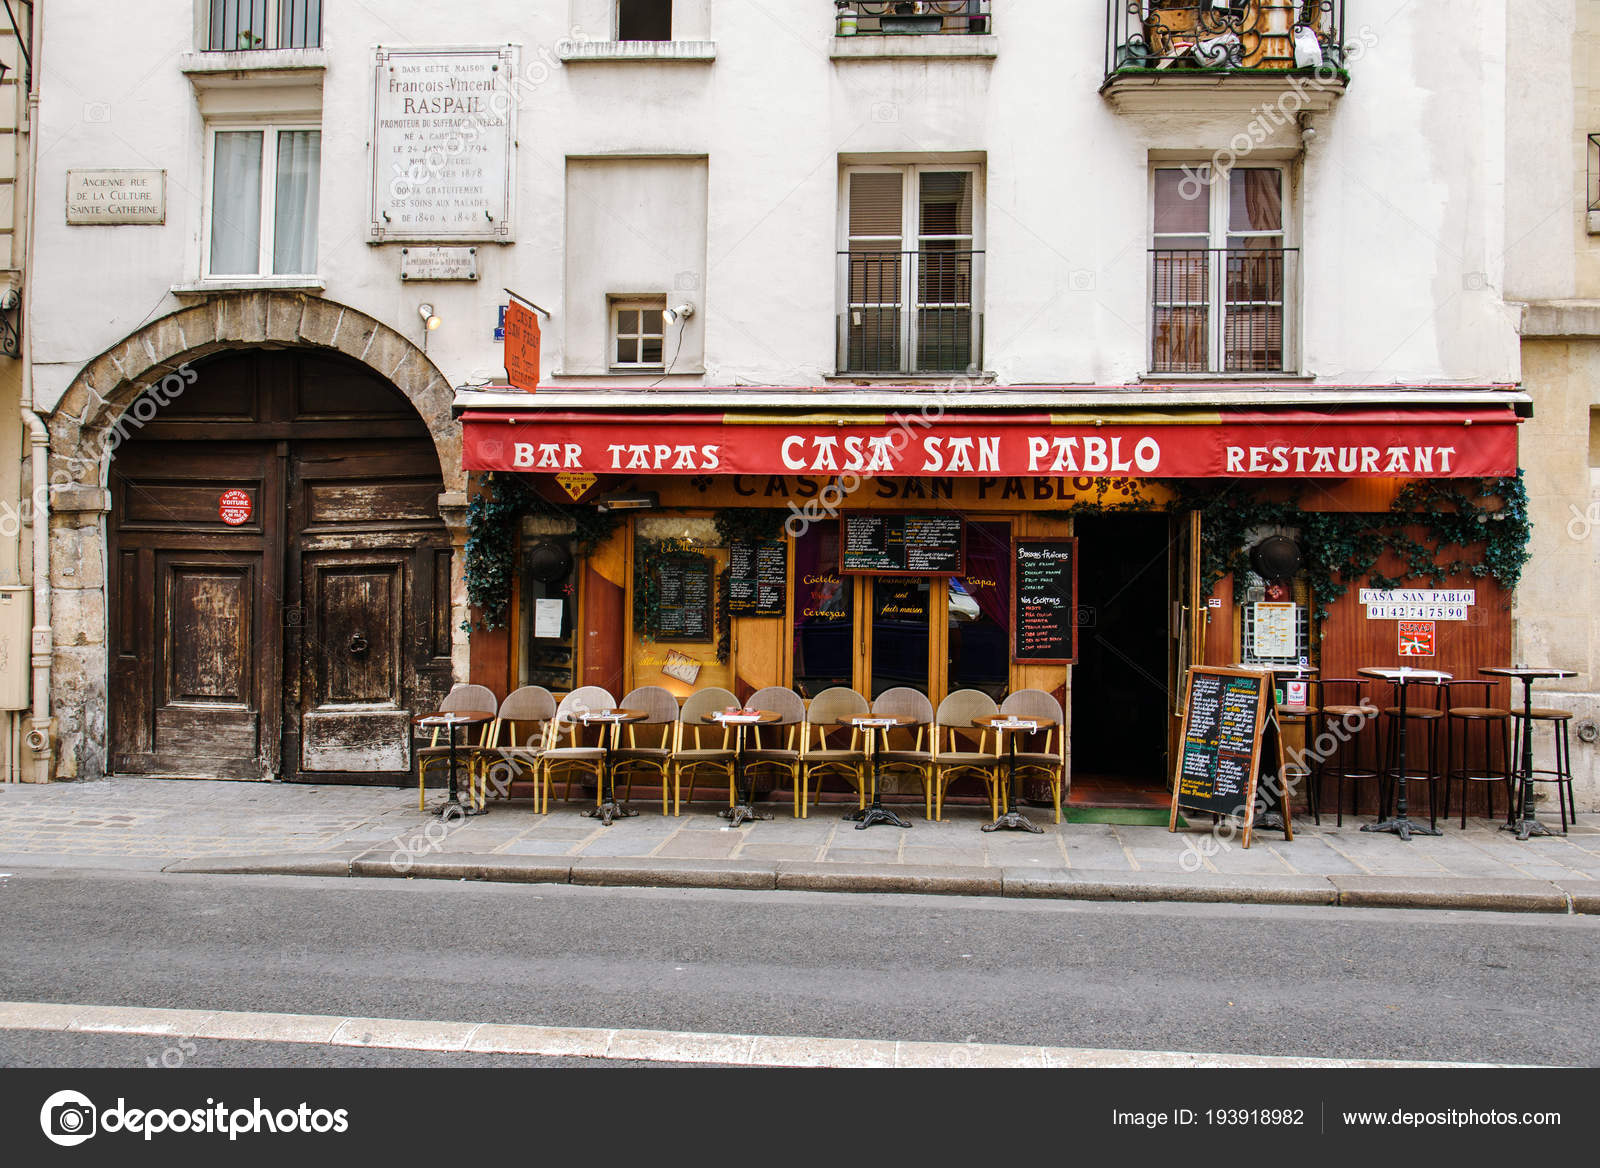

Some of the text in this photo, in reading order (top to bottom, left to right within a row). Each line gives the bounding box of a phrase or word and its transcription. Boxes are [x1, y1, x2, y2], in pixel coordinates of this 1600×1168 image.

[389, 78, 496, 93] François-Vincent
[404, 97, 483, 114] RASPAIL
[380, 120, 419, 129] PROMOTEUR
[422, 120, 431, 128] DU
[393, 145, 403, 153] LE
[83, 178, 148, 186] ANCIENNE RUE
[425, 186, 482, 194] GRATUITEMENT
[77, 191, 152, 200] DE LA CULTURE
[391, 200, 406, 208] SES
[410, 199, 433, 208] SOINS
[436, 199, 450, 208] AUX
[70, 204, 159, 214] SAINTE-CATHERINE
[402, 214, 412, 222] DE
[415, 212, 434, 222] 1840
[513, 435, 1457, 473] BAR TAPAS CASA SAN PABLO RESTAURANT
[876, 475, 952, 499] SAN
[978, 474, 1095, 500] PABLO
[225, 490, 246, 499] SORTIE
[967, 576, 996, 591] Tapas
[1363, 591, 1471, 602] CASA SAN PABLO
[803, 608, 846, 621] Cervezas
[1372, 607, 1463, 618] 01 42 74 75 90
